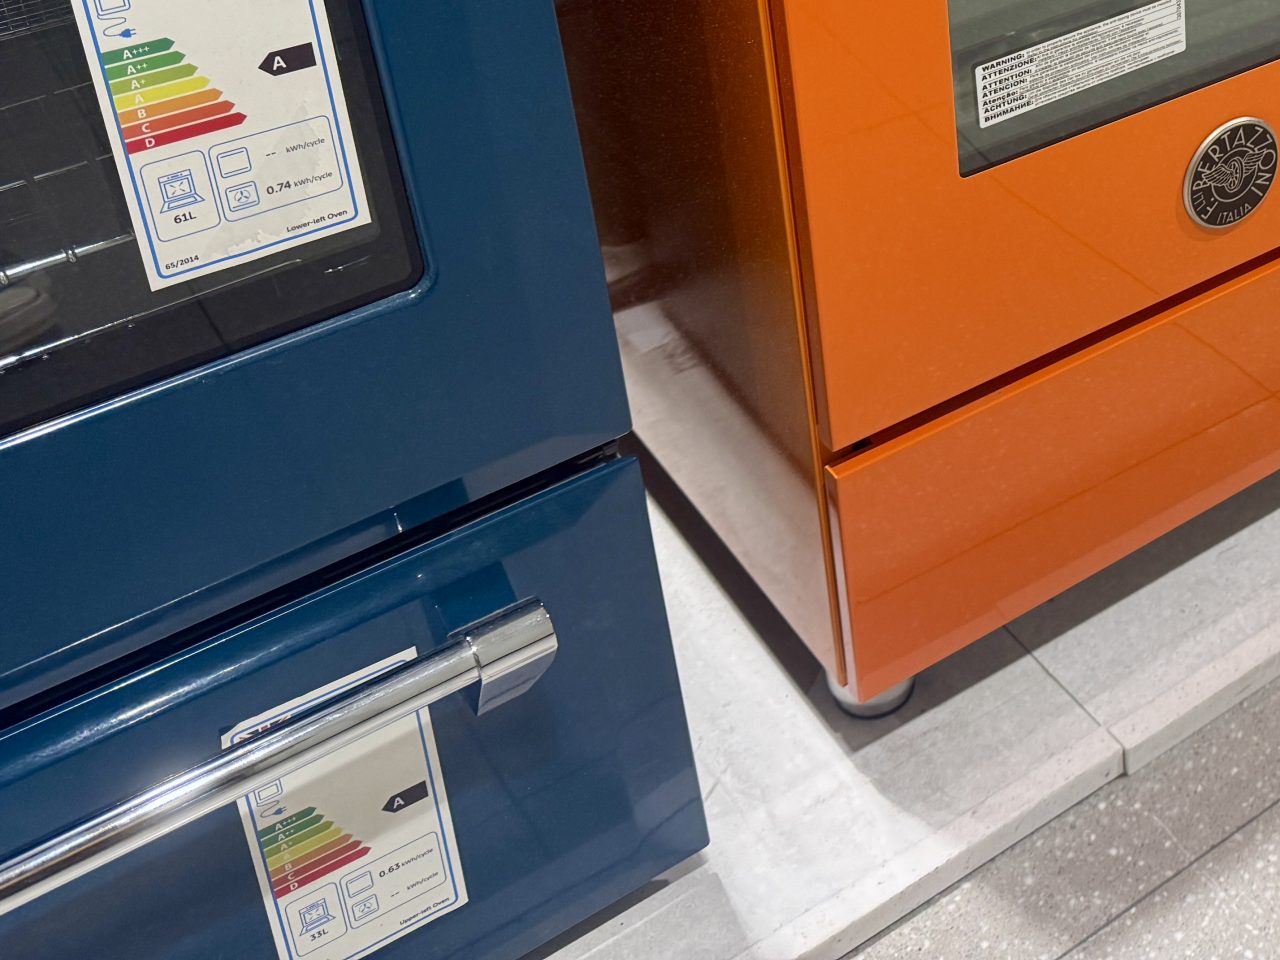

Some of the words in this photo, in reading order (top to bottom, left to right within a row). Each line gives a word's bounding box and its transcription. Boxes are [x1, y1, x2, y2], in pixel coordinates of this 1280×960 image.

[123, 46, 150, 60] A+++
[127, 63, 147, 75] A++
[272, 56, 287, 71] A
[134, 94, 144, 104] A
[137, 109, 147, 119] B
[141, 123, 151, 133] C
[145, 138, 155, 148] D
[286, 138, 325, 153] kWh/cycle
[266, 181, 291, 194] 0.74
[294, 172, 333, 187] kWh/cycle
[174, 212, 197, 224] 61L
[1217, 203, 1252, 224] ITALIA
[286, 215, 325, 233] Lower-left
[328, 209, 348, 220] Oven
[165, 255, 200, 270] 65/2014
[393, 797, 405, 809] A
[288, 872, 296, 880] C
[379, 862, 401, 878] 0.63
[433, 897, 450, 908] Oven
[310, 929, 329, 942] 33L
